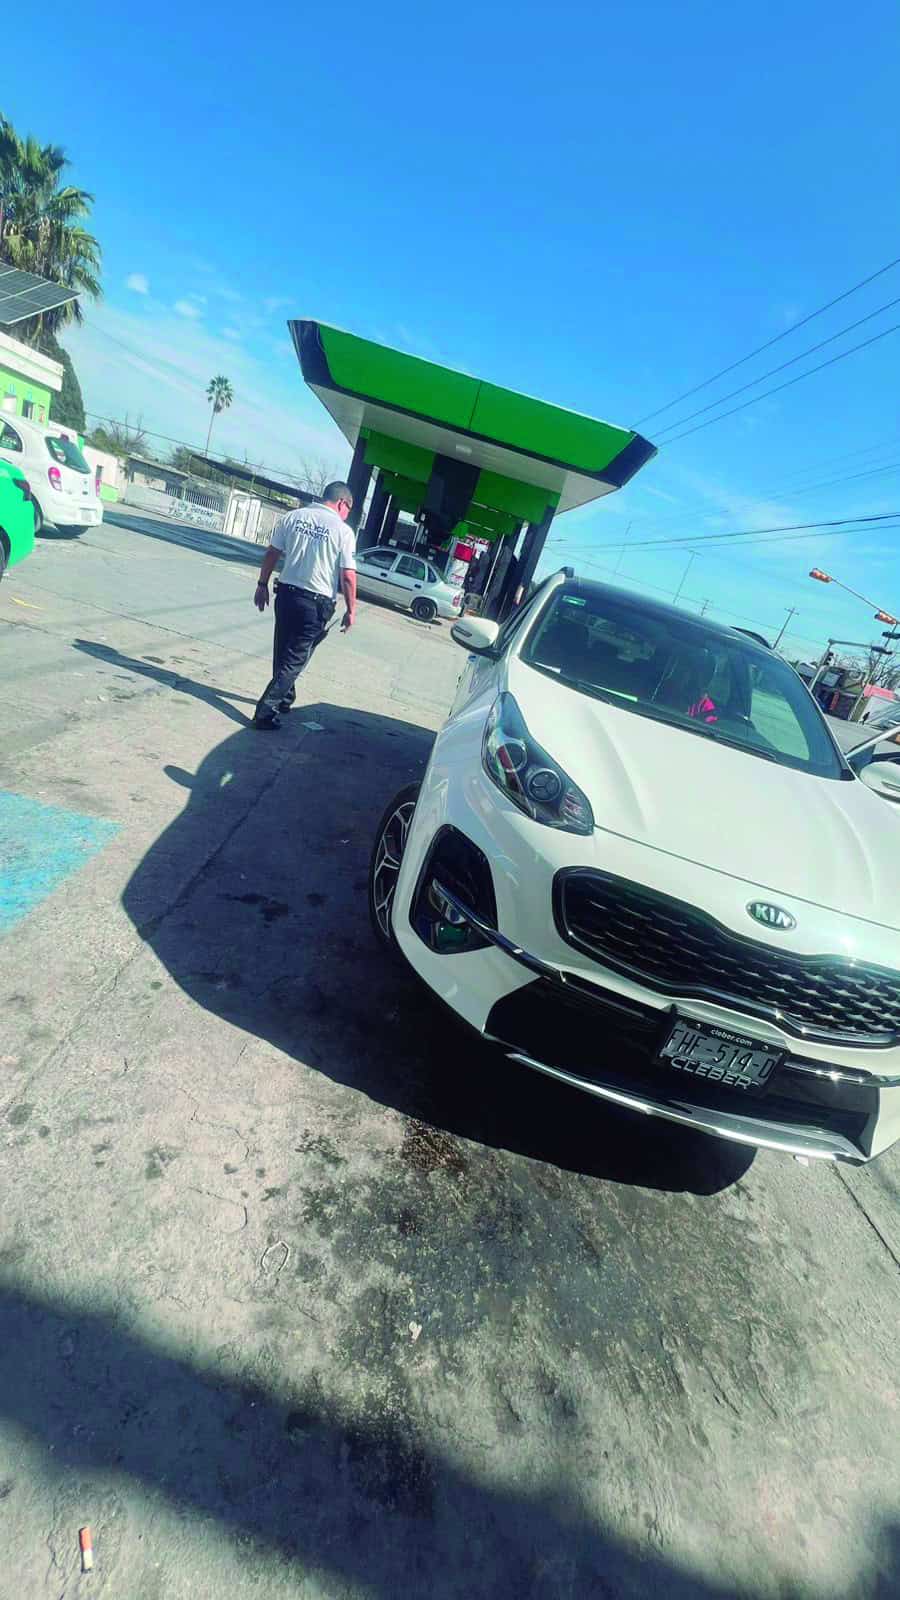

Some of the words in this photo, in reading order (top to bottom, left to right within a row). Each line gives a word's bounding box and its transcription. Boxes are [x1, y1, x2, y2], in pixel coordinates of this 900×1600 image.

[755, 903, 792, 928] KIA
[711, 1028, 753, 1047] cleber.com
[670, 1057, 751, 1090] CLEBER
